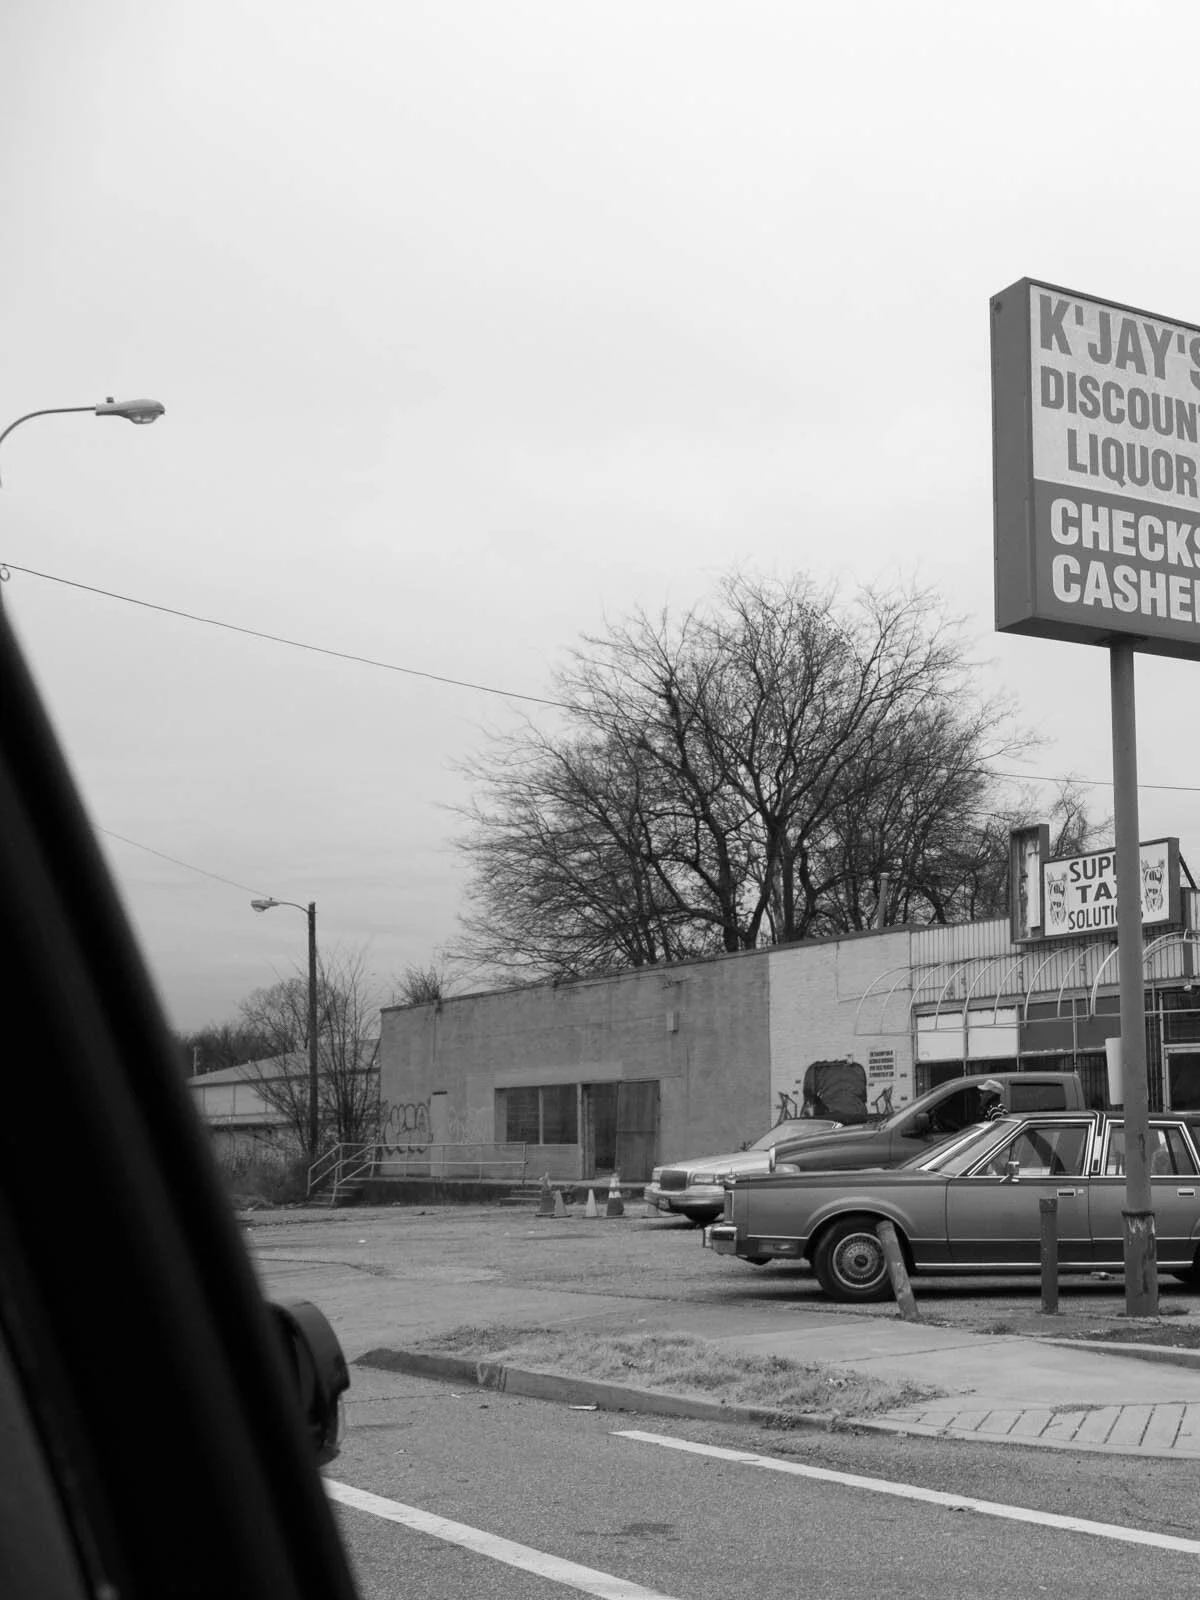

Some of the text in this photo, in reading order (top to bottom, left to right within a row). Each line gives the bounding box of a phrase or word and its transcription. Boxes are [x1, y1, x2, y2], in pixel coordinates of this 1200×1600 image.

[1067, 428, 1198, 498] LIQUOR
[1070, 854, 1117, 883] SUP
[1068, 902, 1118, 931] SOLUTI
